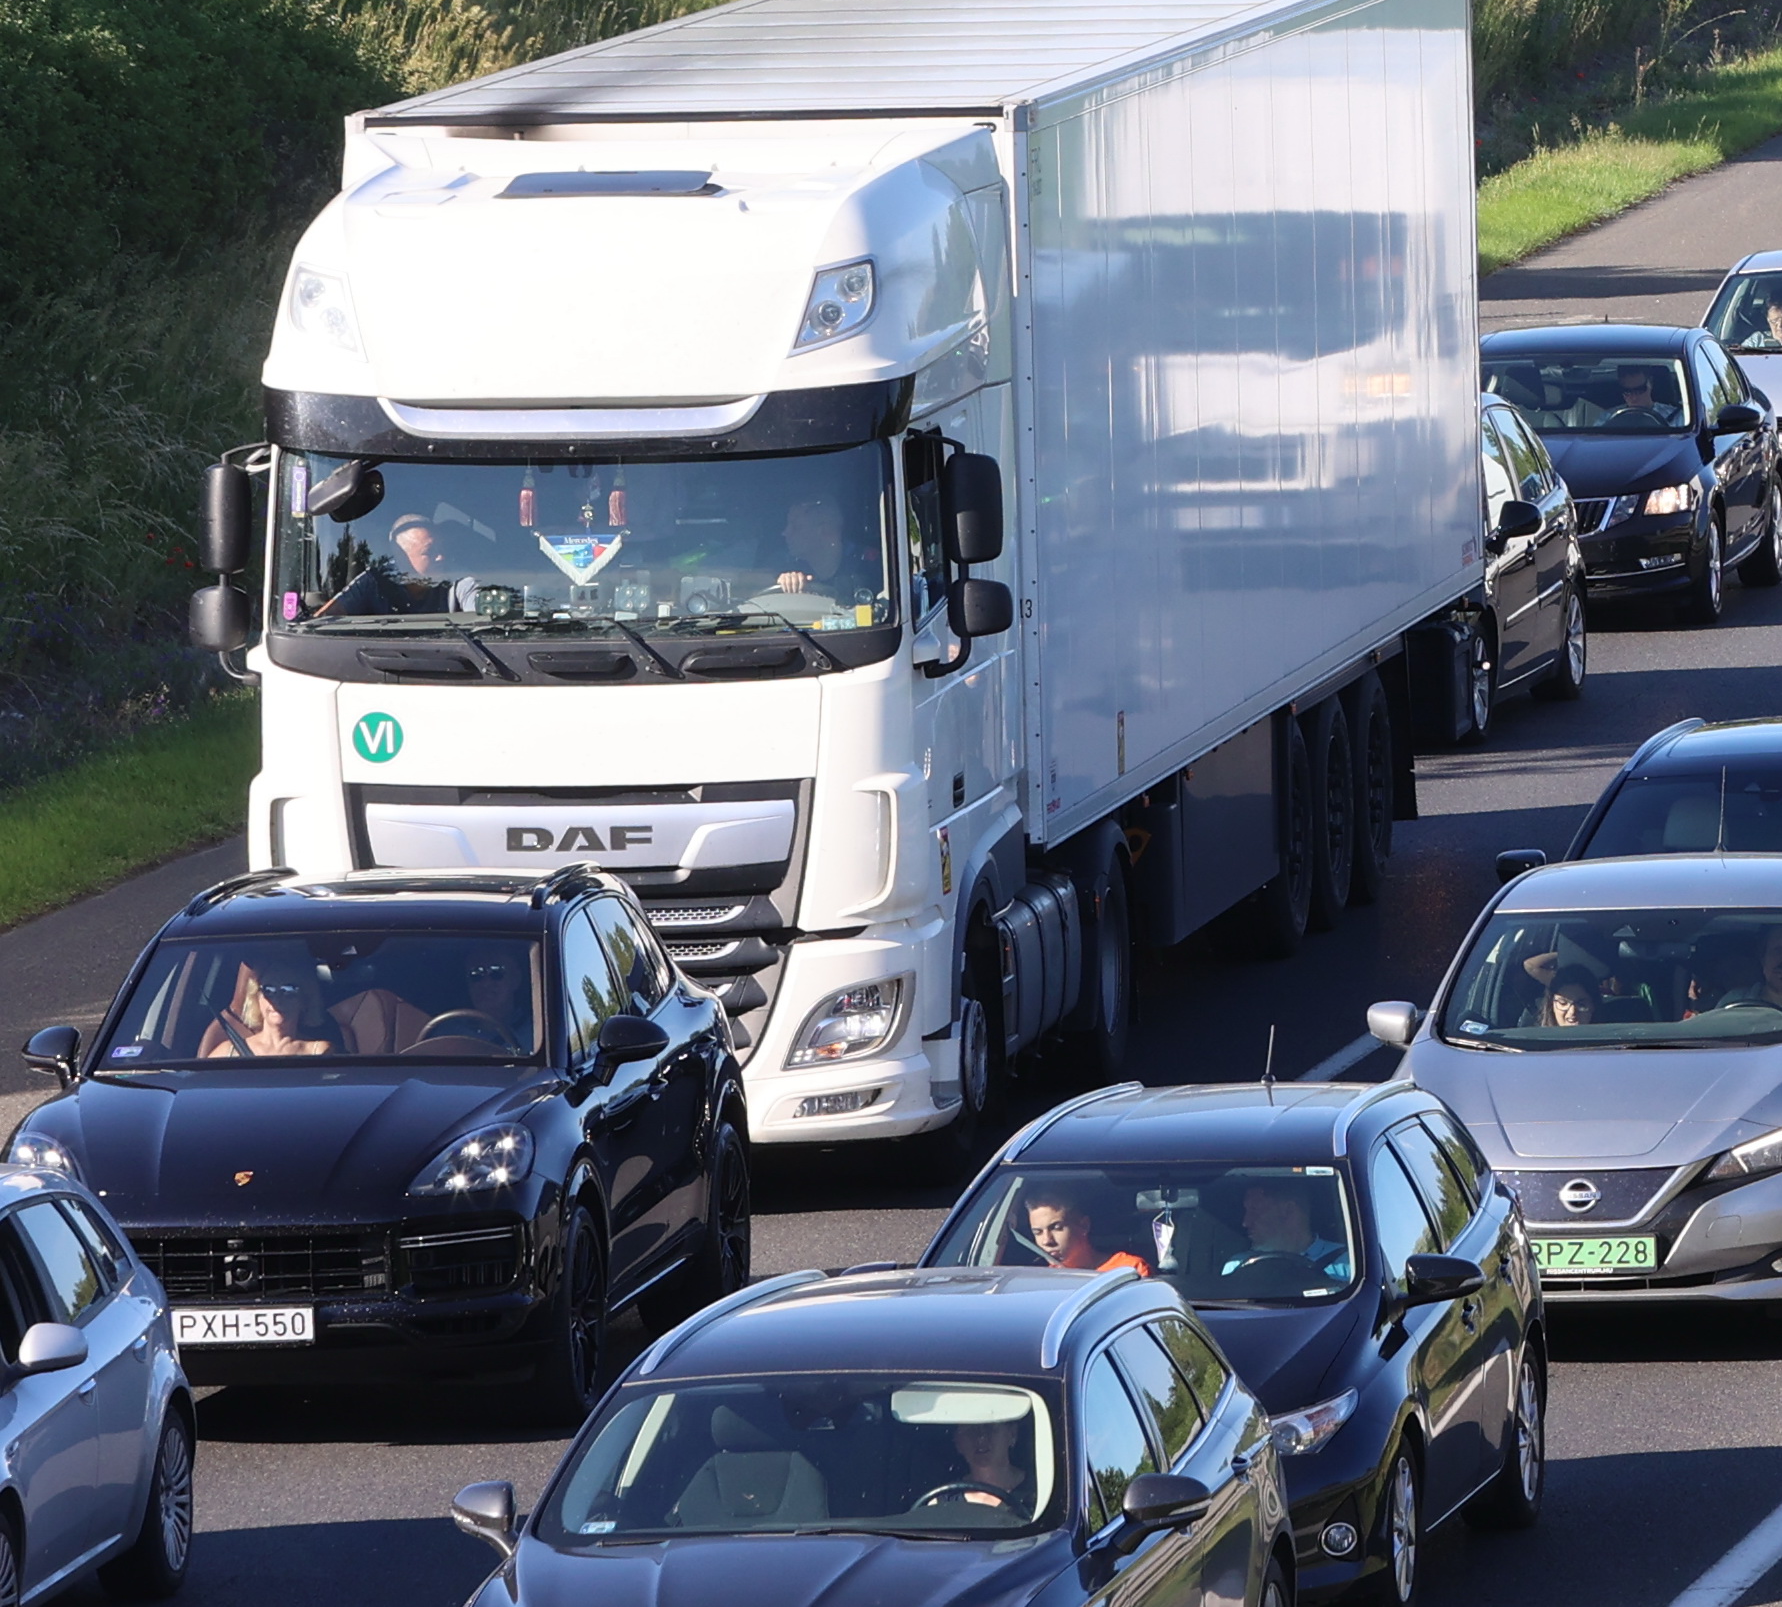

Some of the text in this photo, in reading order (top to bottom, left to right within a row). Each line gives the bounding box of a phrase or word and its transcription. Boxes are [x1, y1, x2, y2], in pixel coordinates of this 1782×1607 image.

[563, 536, 599, 545] Mercedes
[359, 720, 394, 755] VI
[506, 825, 654, 852] DAF
[1530, 1240, 1648, 1266] RPZ-228
[179, 1311, 306, 1339] PXH-550
